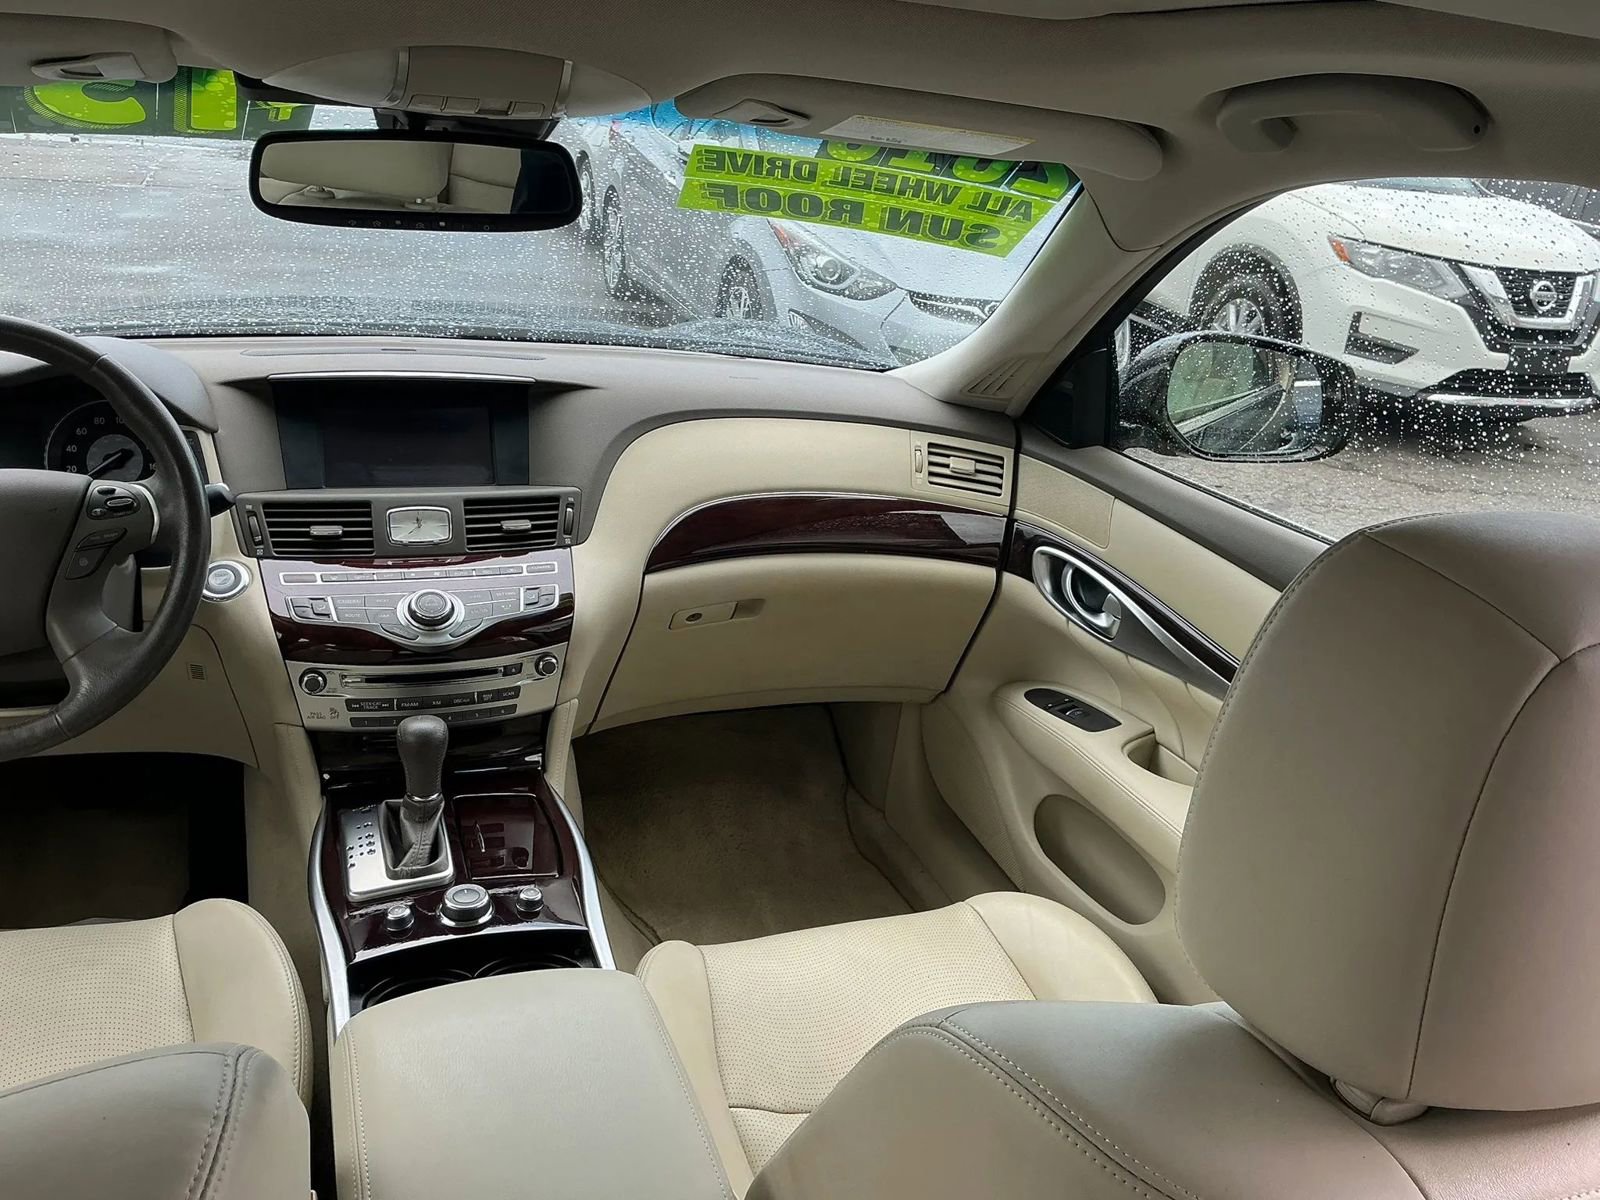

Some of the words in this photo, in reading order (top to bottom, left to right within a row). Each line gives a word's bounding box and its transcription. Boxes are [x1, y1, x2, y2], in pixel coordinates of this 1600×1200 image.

[93, 417, 106, 425] 80
[75, 427, 88, 436] 60
[65, 444, 78, 453] 40
[65, 465, 78, 473] 20
